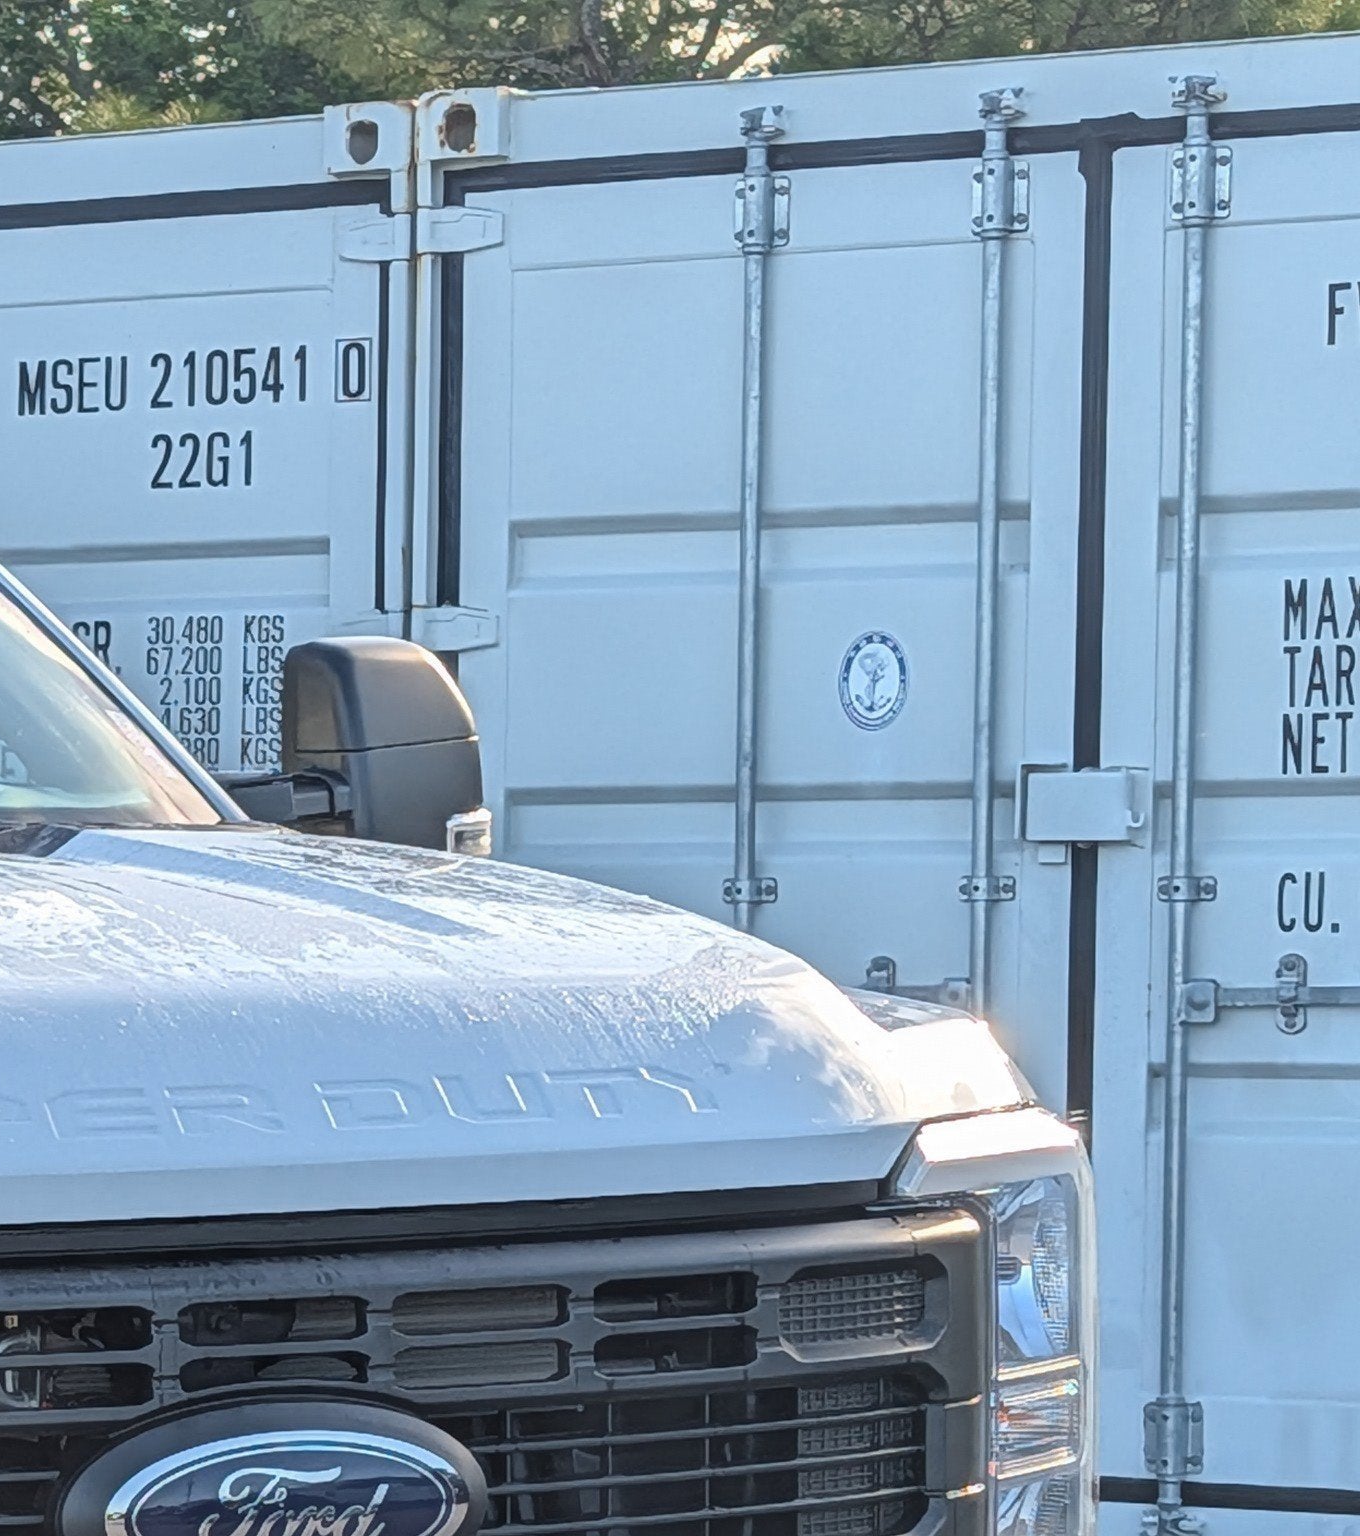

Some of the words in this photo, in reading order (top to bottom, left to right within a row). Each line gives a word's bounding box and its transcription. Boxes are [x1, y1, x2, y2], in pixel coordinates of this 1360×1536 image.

[1327, 282, 1360, 346] F
[17, 355, 128, 416] MSEU
[149, 344, 308, 409] 210541
[340, 340, 369, 400] 0
[150, 430, 253, 489] 22G1
[146, 615, 224, 646] 30.480
[243, 614, 286, 645] KGS
[146, 646, 223, 676] 67.200
[242, 645, 286, 675] LBS
[159, 677, 222, 706] 2.100
[242, 677, 284, 706] KGS
[240, 707, 284, 736] LBS
[1281, 711, 1354, 775] NET
[240, 738, 283, 765] KGS
[1276, 872, 1341, 934] CU.
[312, 1063, 730, 1134] DUTY
